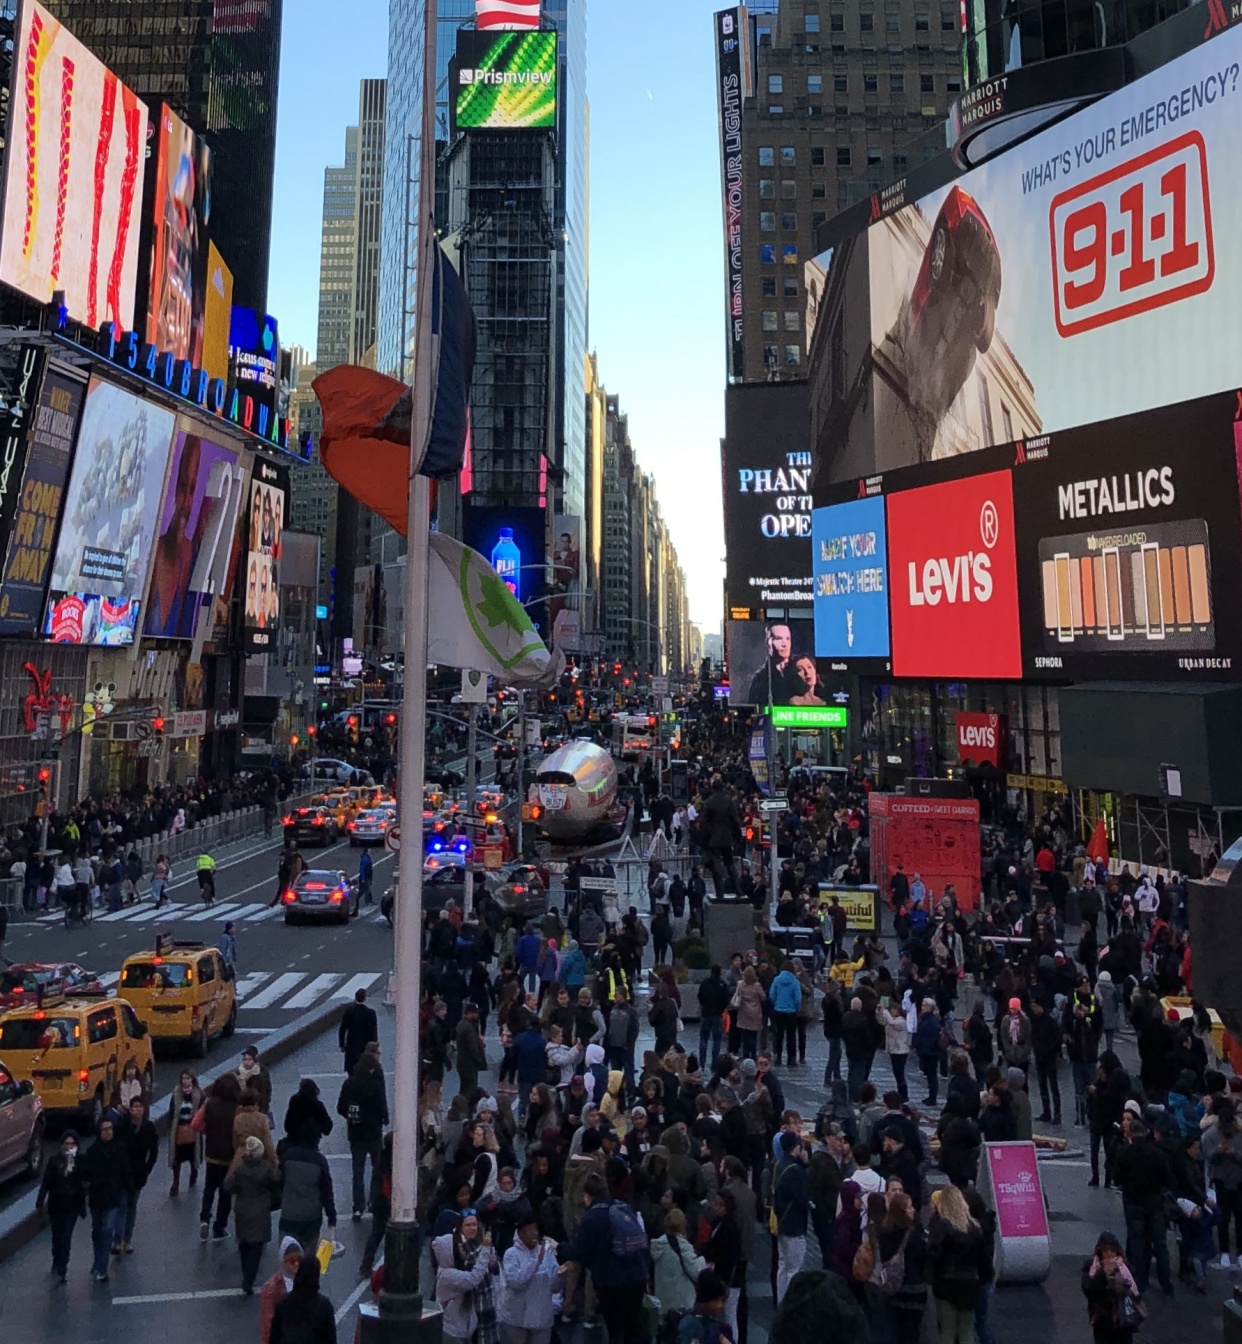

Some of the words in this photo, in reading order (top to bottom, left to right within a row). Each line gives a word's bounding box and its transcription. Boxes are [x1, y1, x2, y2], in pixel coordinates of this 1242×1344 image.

[474, 68, 552, 84] Prismview
[961, 77, 1008, 110] MARRIOTT
[723, 73, 741, 153] LIGHTS
[962, 97, 1002, 127] MARQUIS
[1022, 150, 1071, 195] WHAT'S
[1074, 127, 1116, 168] YOUR
[1121, 63, 1240, 147] EMERGENCY?
[727, 154, 743, 224] YOUR
[1026, 436, 1050, 450] MARRIOTT
[1026, 447, 1049, 460] MARQUIS
[23, 478, 62, 518] COME
[1058, 466, 1175, 520] METALLICS
[7, 546, 49, 584] AWAY
[856, 567, 884, 594] HERE
[1035, 657, 1063, 668] SEPHORA
[1178, 658, 1205, 671] URBAN
[1205, 658, 1231, 669] DECAY
[796, 711, 842, 723] FRIENDS
[891, 804, 931, 813] COFFEED
